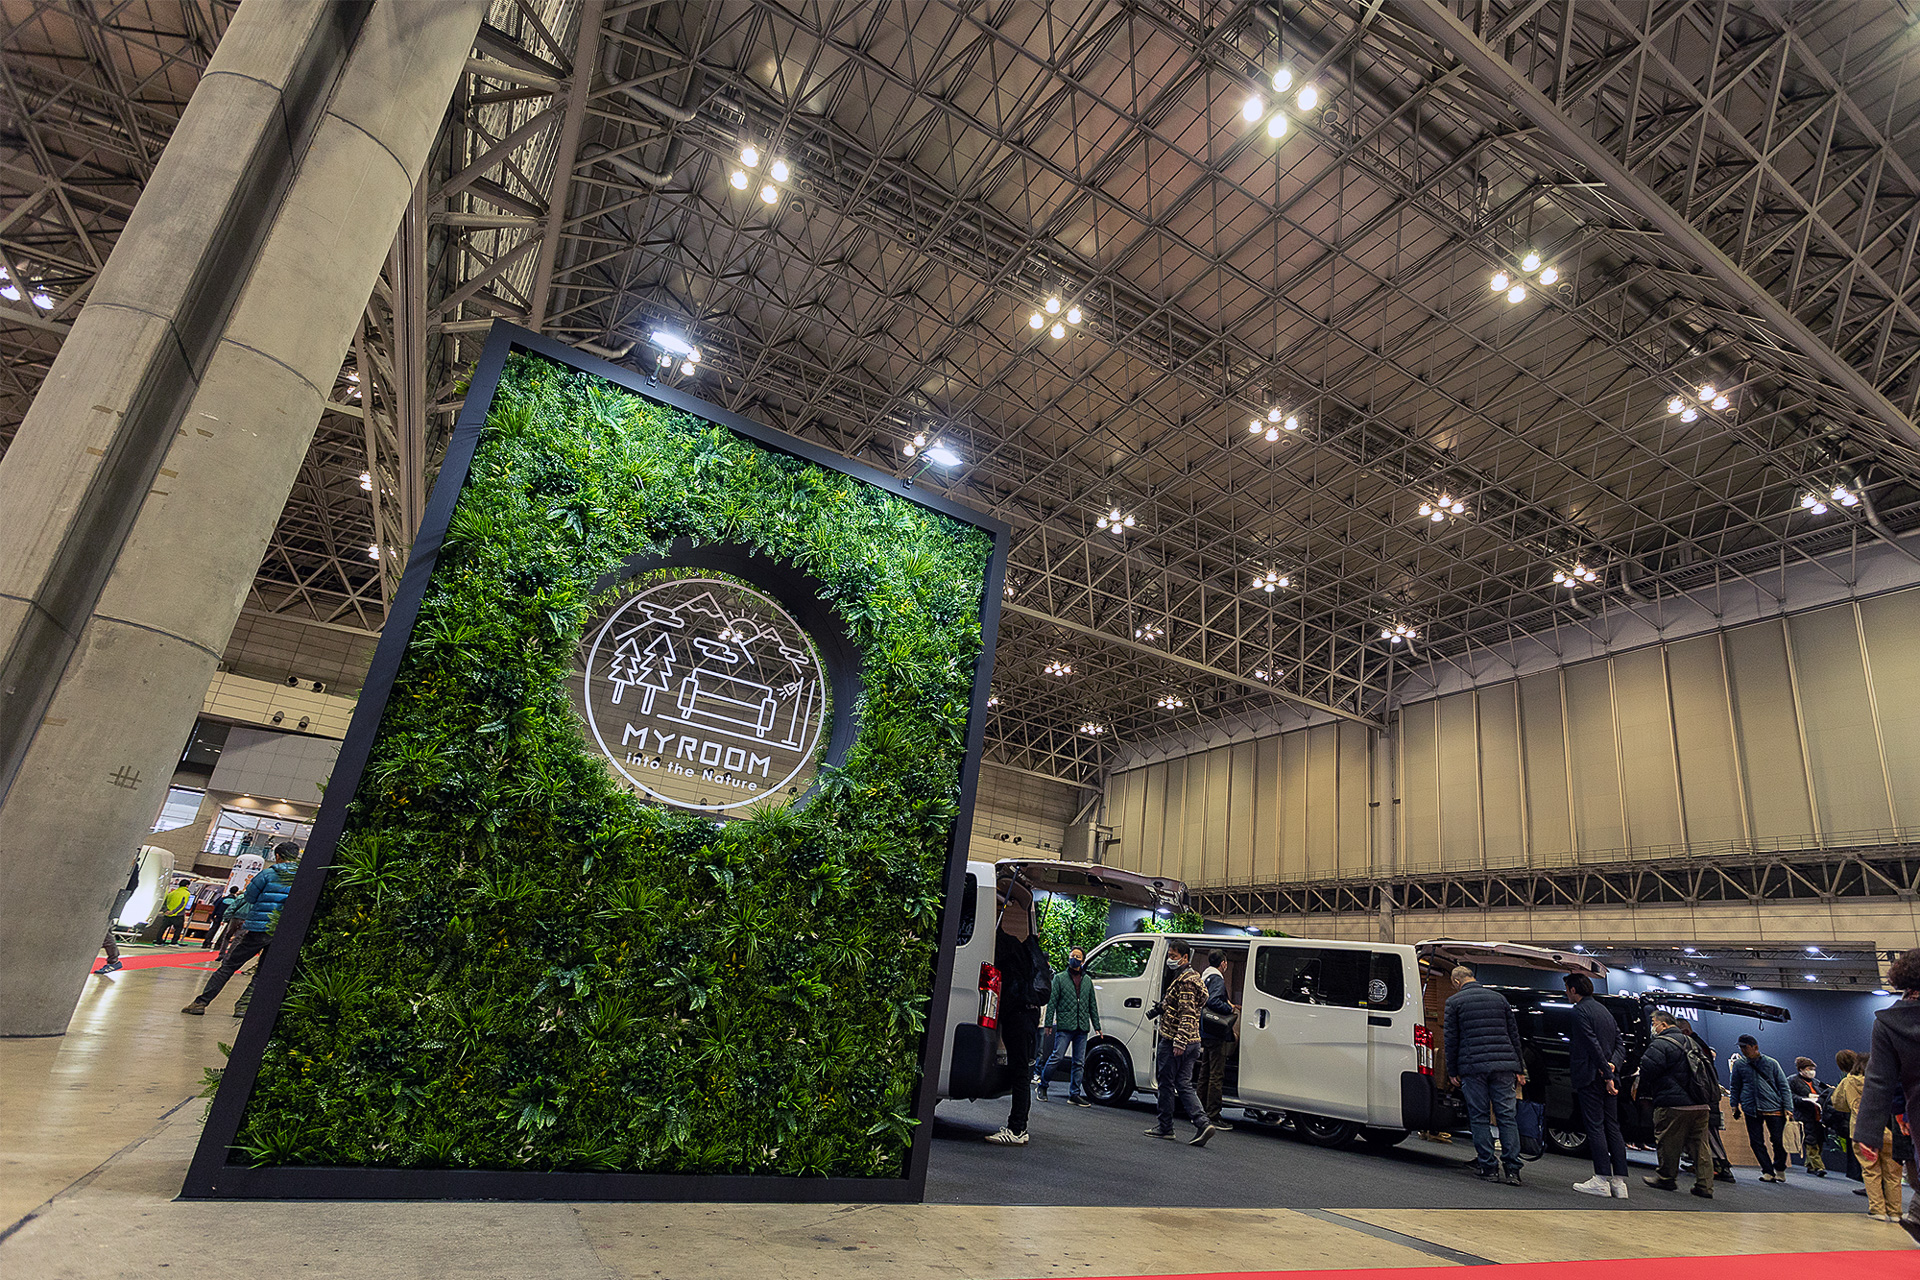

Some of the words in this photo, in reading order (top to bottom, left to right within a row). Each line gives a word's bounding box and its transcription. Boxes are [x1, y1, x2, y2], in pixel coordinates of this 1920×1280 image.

[621, 722, 771, 778] MYROOM
[625, 752, 661, 770] into
[667, 761, 695, 778] the
[702, 769, 758, 791] Nature
